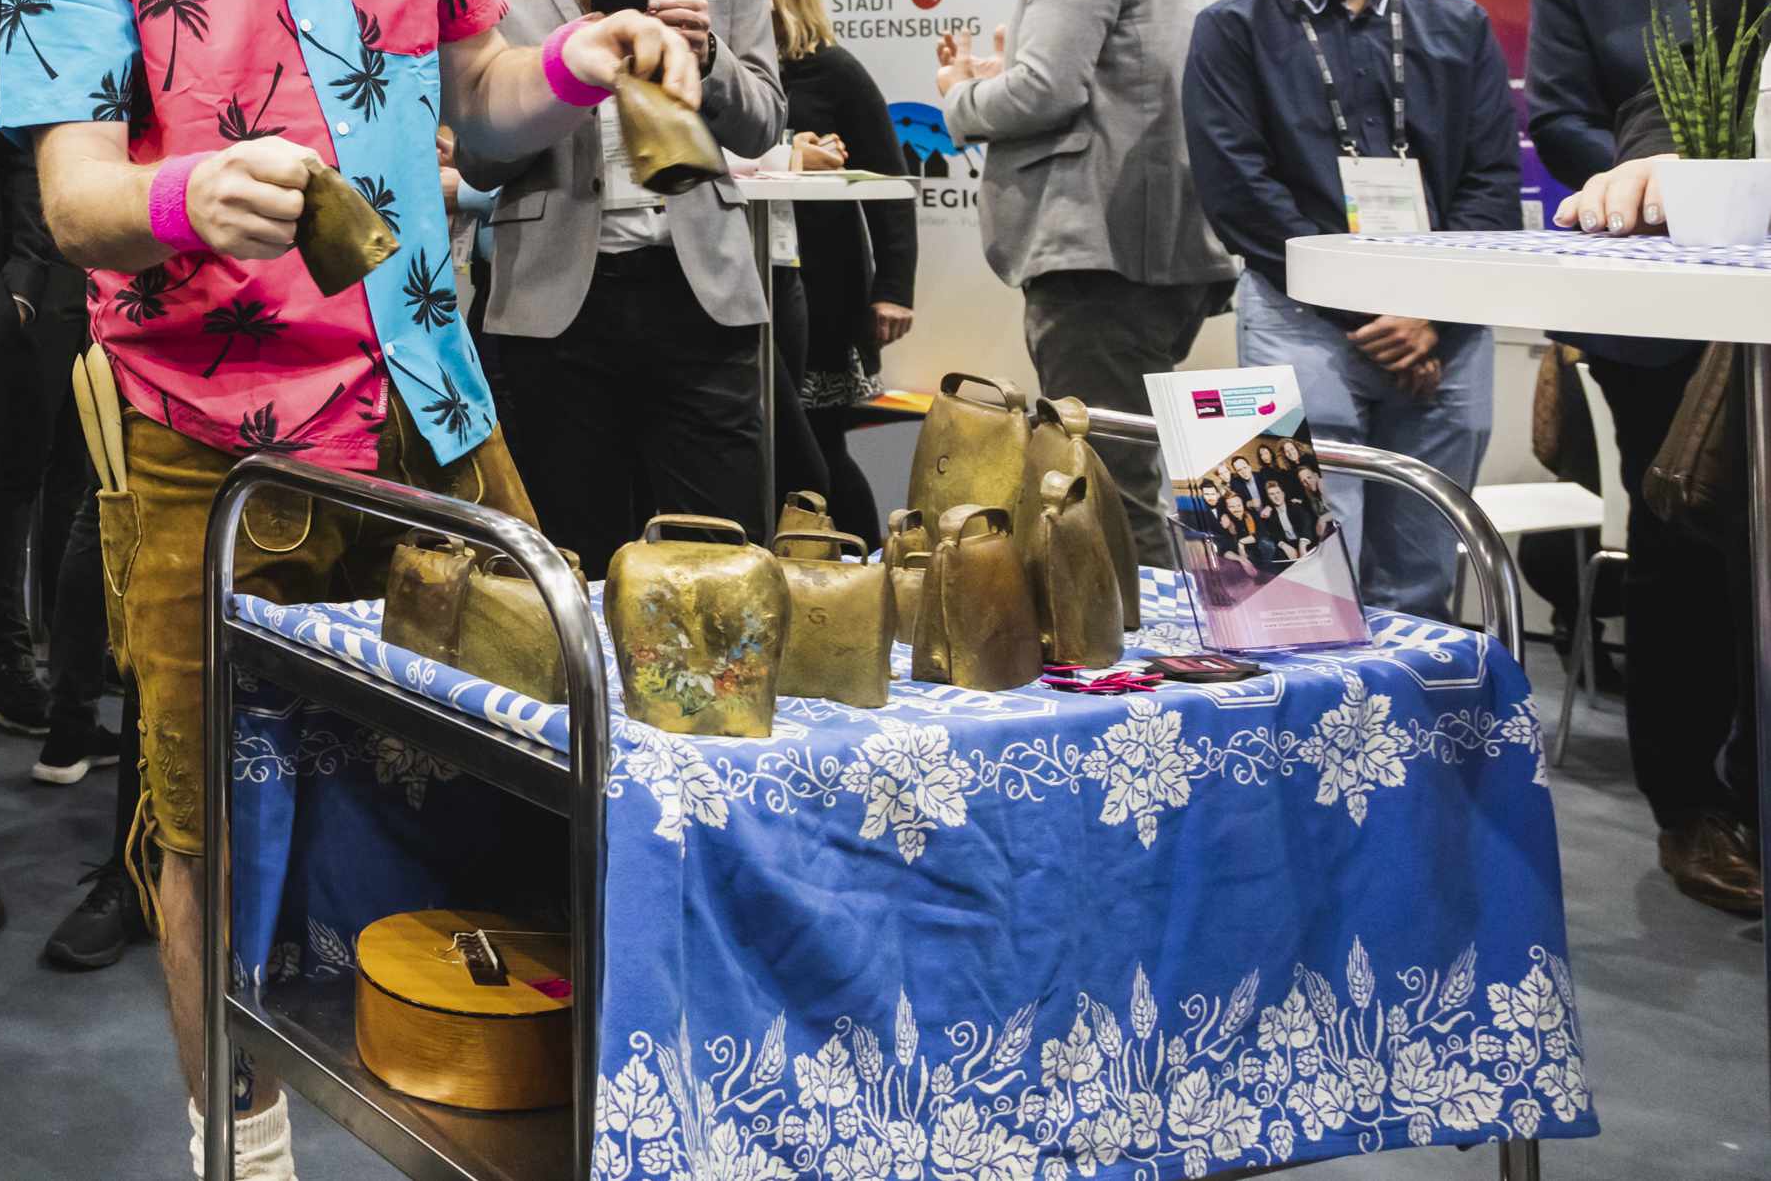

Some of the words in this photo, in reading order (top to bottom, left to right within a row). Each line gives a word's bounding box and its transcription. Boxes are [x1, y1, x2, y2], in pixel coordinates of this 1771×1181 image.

[833, 16, 981, 39] REGENSBURG
[922, 188, 978, 209] EGI
[937, 455, 949, 475] C
[808, 607, 827, 626] G
